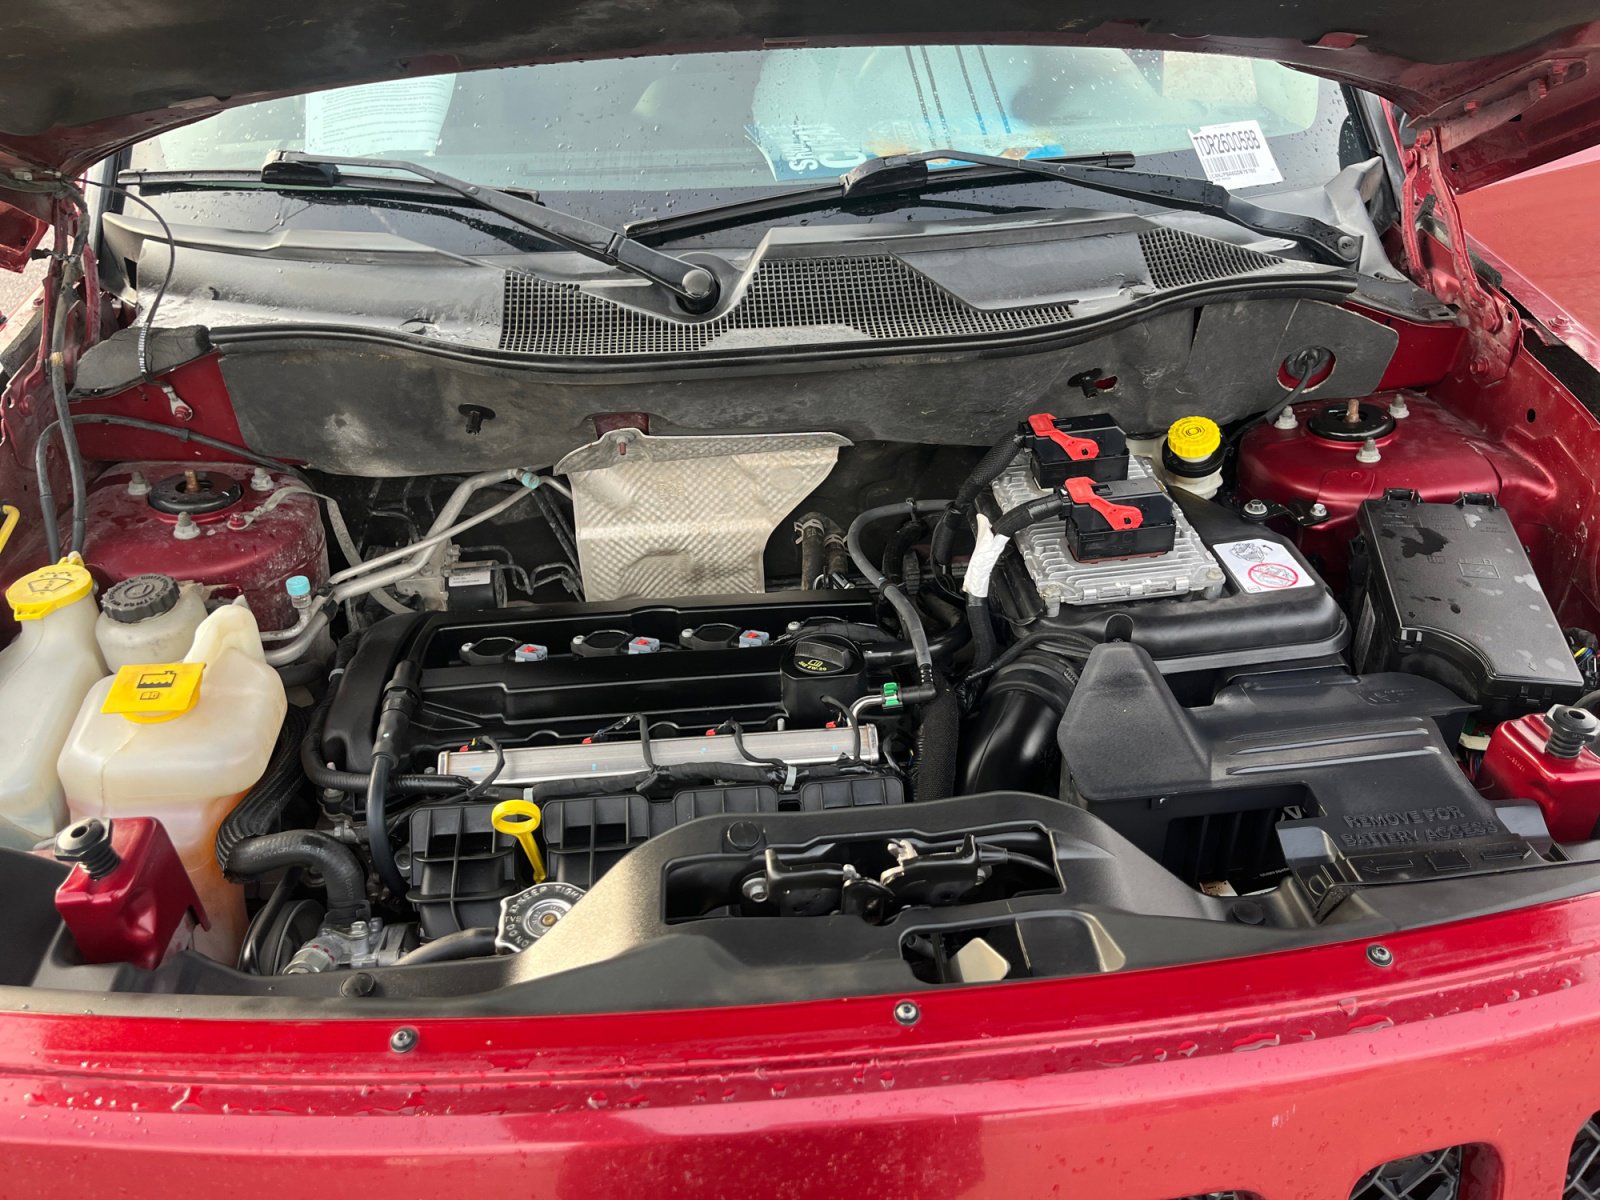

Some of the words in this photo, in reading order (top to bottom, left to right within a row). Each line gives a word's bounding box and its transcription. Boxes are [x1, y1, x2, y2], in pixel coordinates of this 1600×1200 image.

[1343, 810, 1424, 829] REMOVE
[1423, 805, 1465, 822] FOR
[1341, 830, 1420, 848] BATTERY
[1424, 820, 1498, 842] ACCESS
[517, 886, 548, 905] KEEP
